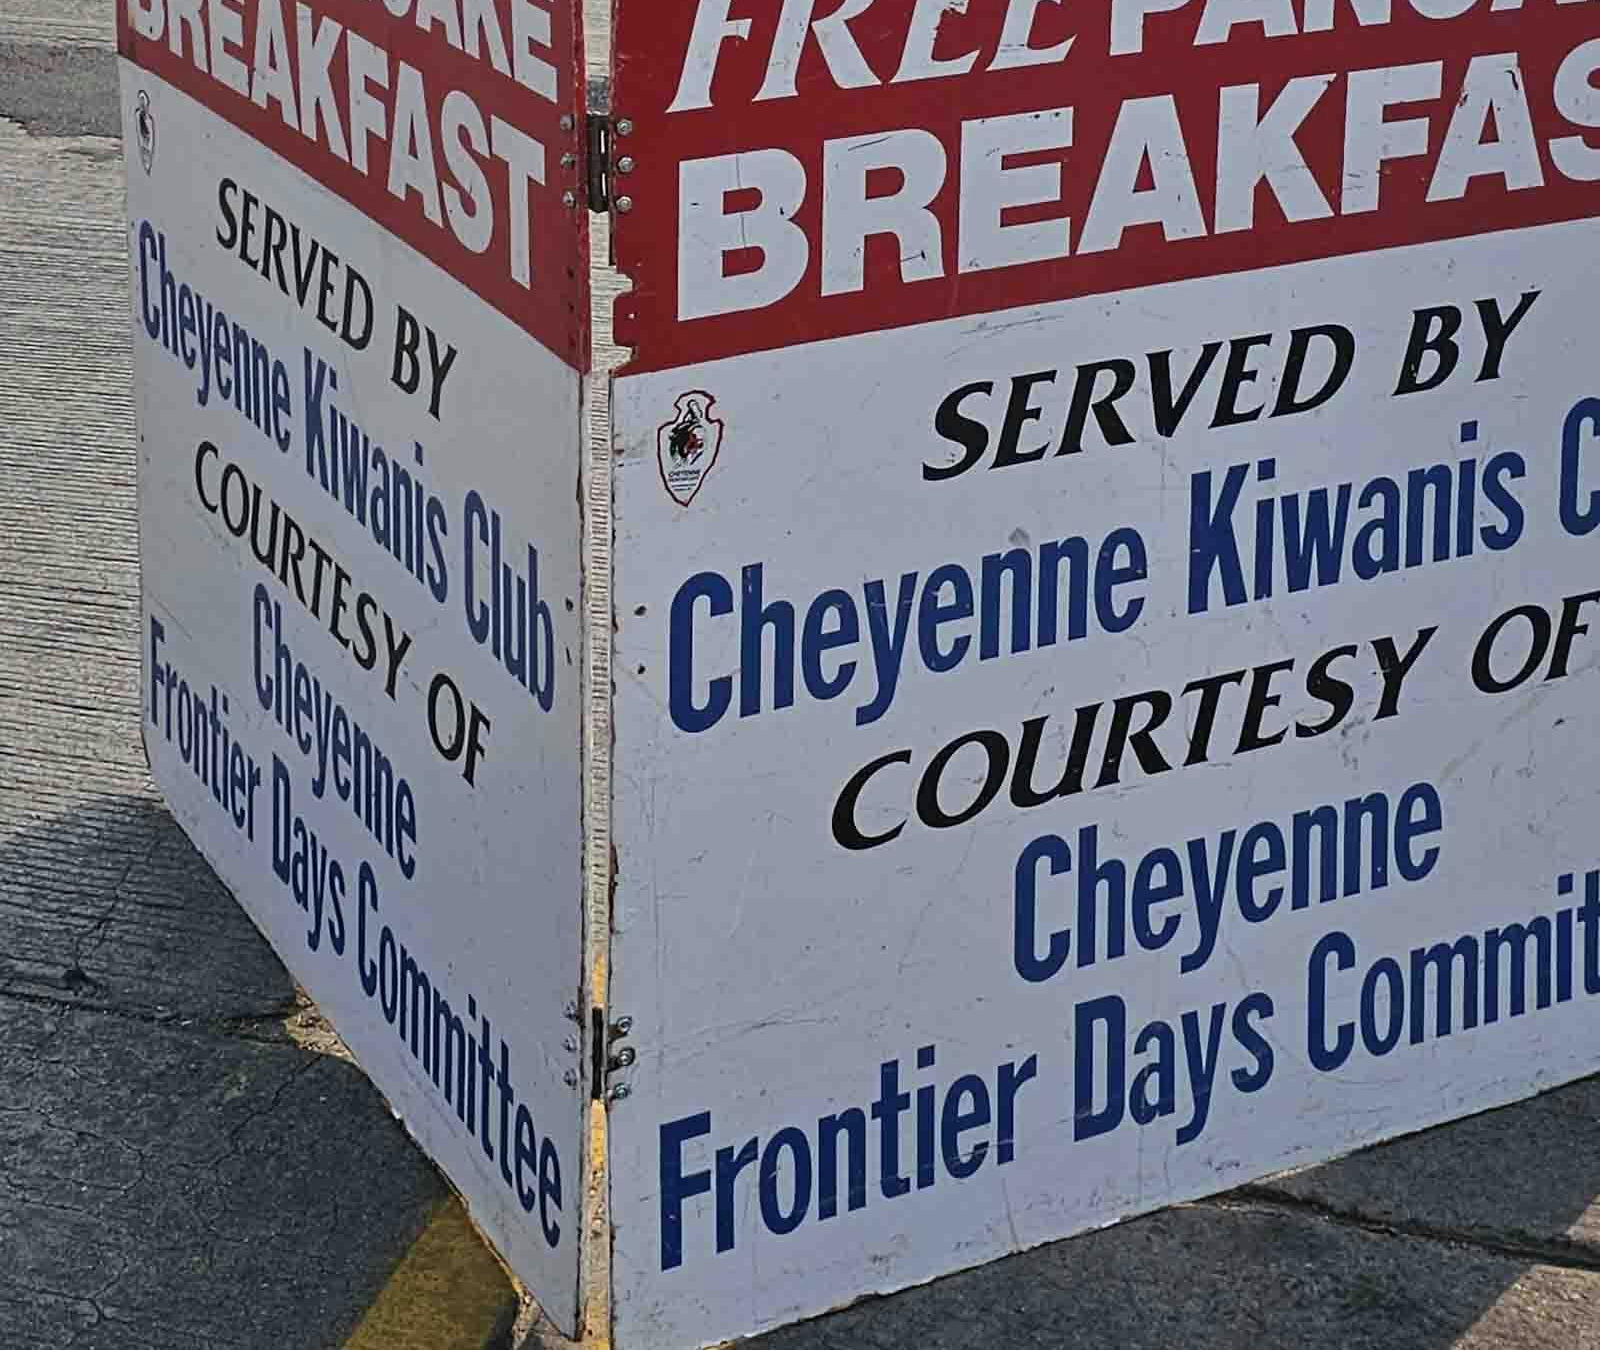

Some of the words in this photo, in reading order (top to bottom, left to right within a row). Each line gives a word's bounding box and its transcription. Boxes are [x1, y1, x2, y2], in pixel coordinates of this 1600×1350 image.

[215, 177, 375, 351] SERVED
[390, 305, 458, 422] BY
[921, 323, 1356, 482] SERVED
[1391, 289, 1543, 397] BY
[137, 219, 291, 452] Cheyenne
[303, 345, 448, 604] Kiwanis
[463, 489, 554, 713] Club
[668, 526, 1149, 734] Cheyenne
[1187, 419, 1526, 615] Kiwanis
[194, 440, 413, 701] COURTESY
[427, 673, 491, 788] OF
[253, 582, 417, 881] Cheyenne
[831, 625, 1440, 852] COURTESY
[150, 613, 261, 843] Frontier
[272, 752, 346, 957] Days
[357, 860, 562, 1250] Committee
[1013, 782, 1443, 983] Cheyenne
[659, 1044, 1038, 1272] Frontier
[1073, 993, 1275, 1147] Days
